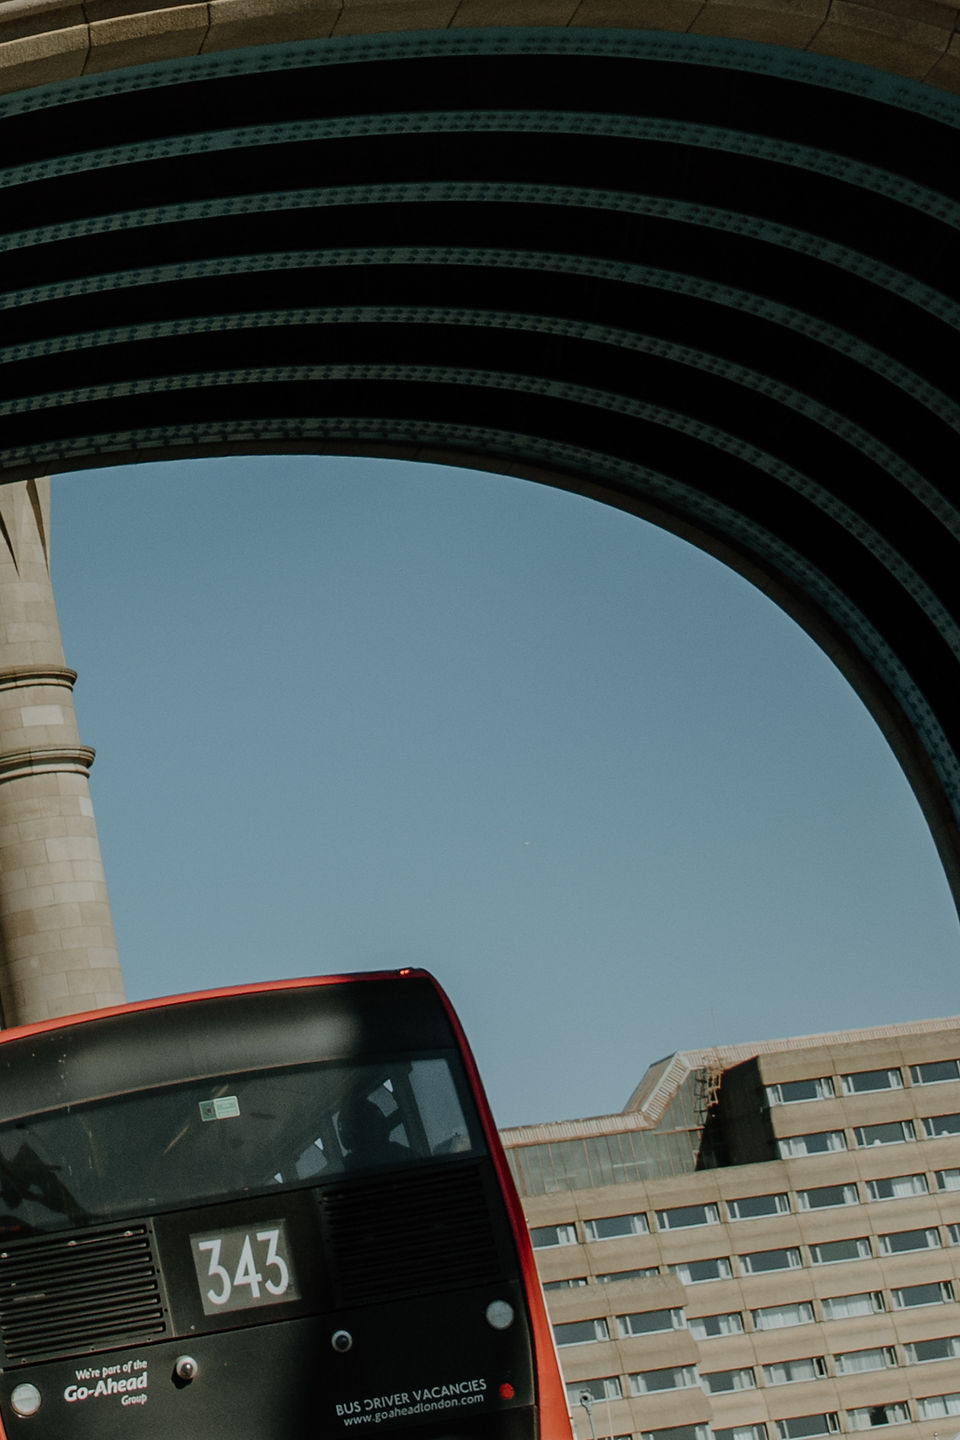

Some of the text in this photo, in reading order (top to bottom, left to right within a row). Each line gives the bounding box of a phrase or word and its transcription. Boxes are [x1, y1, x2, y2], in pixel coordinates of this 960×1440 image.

[198, 1229, 289, 1305] 343
[75, 1359, 148, 1381] We're part of the
[63, 1371, 148, 1403] Go-Ahead
[121, 1393, 148, 1407] Group
[335, 1378, 487, 1416] BUS DRIVER VACANCIES
[343, 1394, 485, 1427] www.goaheadlondon.com
